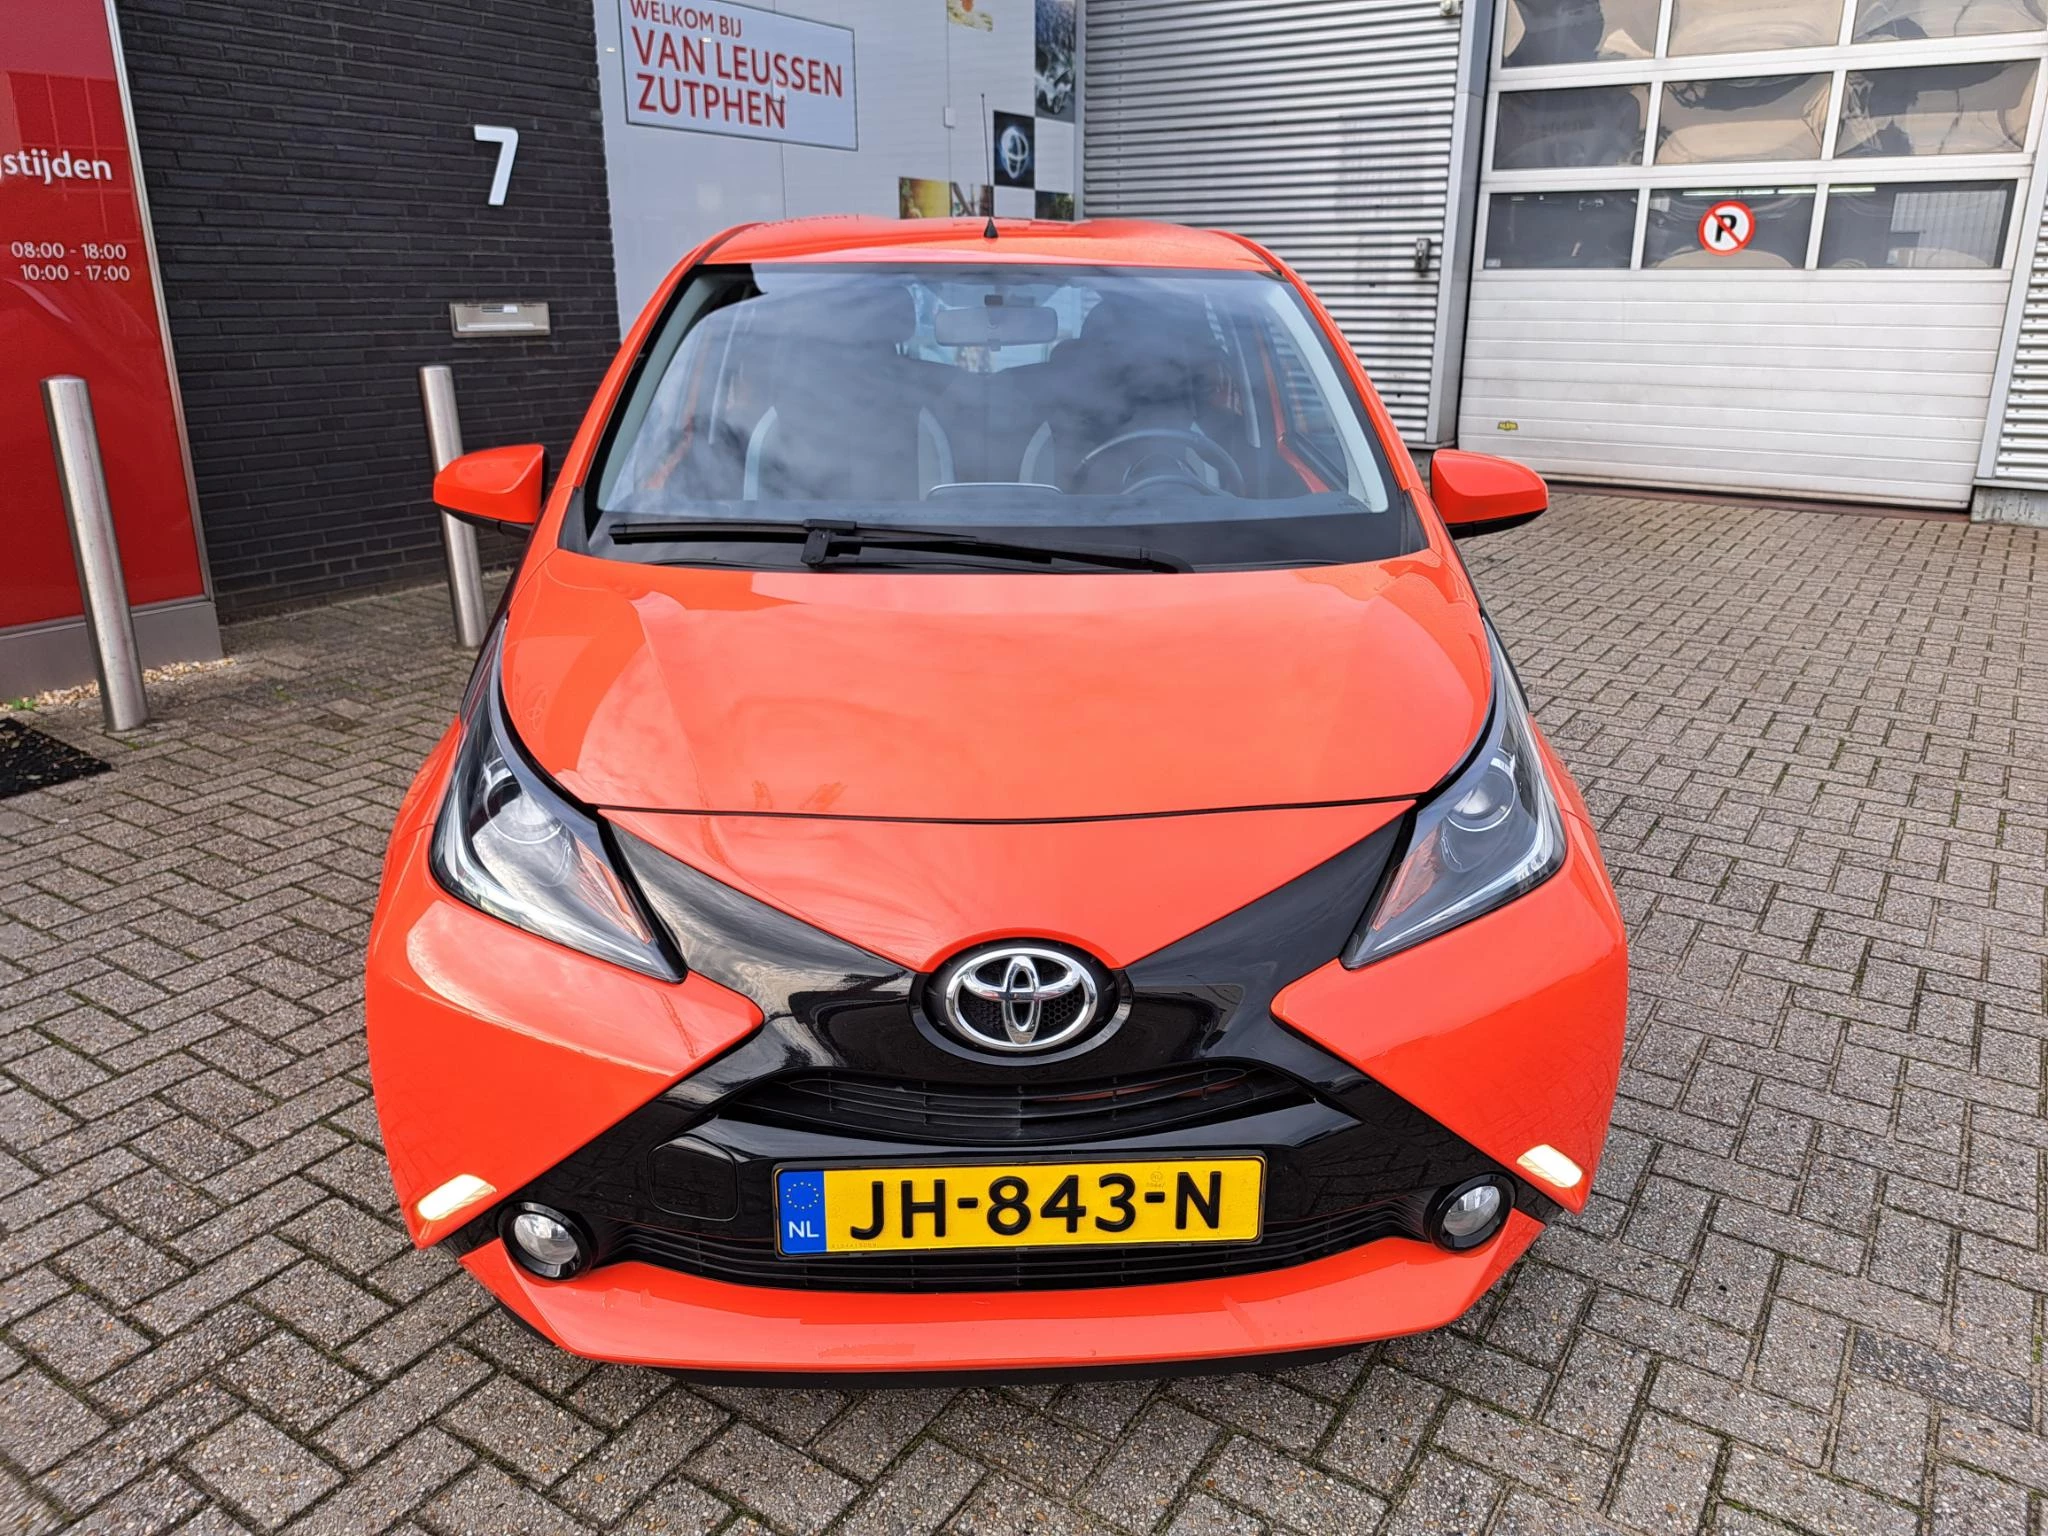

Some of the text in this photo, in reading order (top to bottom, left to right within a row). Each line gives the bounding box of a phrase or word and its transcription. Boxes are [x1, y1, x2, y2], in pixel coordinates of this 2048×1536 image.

[630, 0, 742, 38] WELKOM BIJ
[631, 26, 843, 98] VAN LEUSSEN
[637, 73, 786, 129] ZUTPHEN
[0, 149, 112, 185] stijden
[474, 124, 519, 206] 7
[11, 241, 65, 259] 08:00
[81, 243, 127, 260] 18:00
[20, 263, 69, 281] 10:00
[85, 264, 130, 281] 17:00
[850, 1171, 1222, 1240] JH-843-N
[788, 1220, 820, 1238] NL
